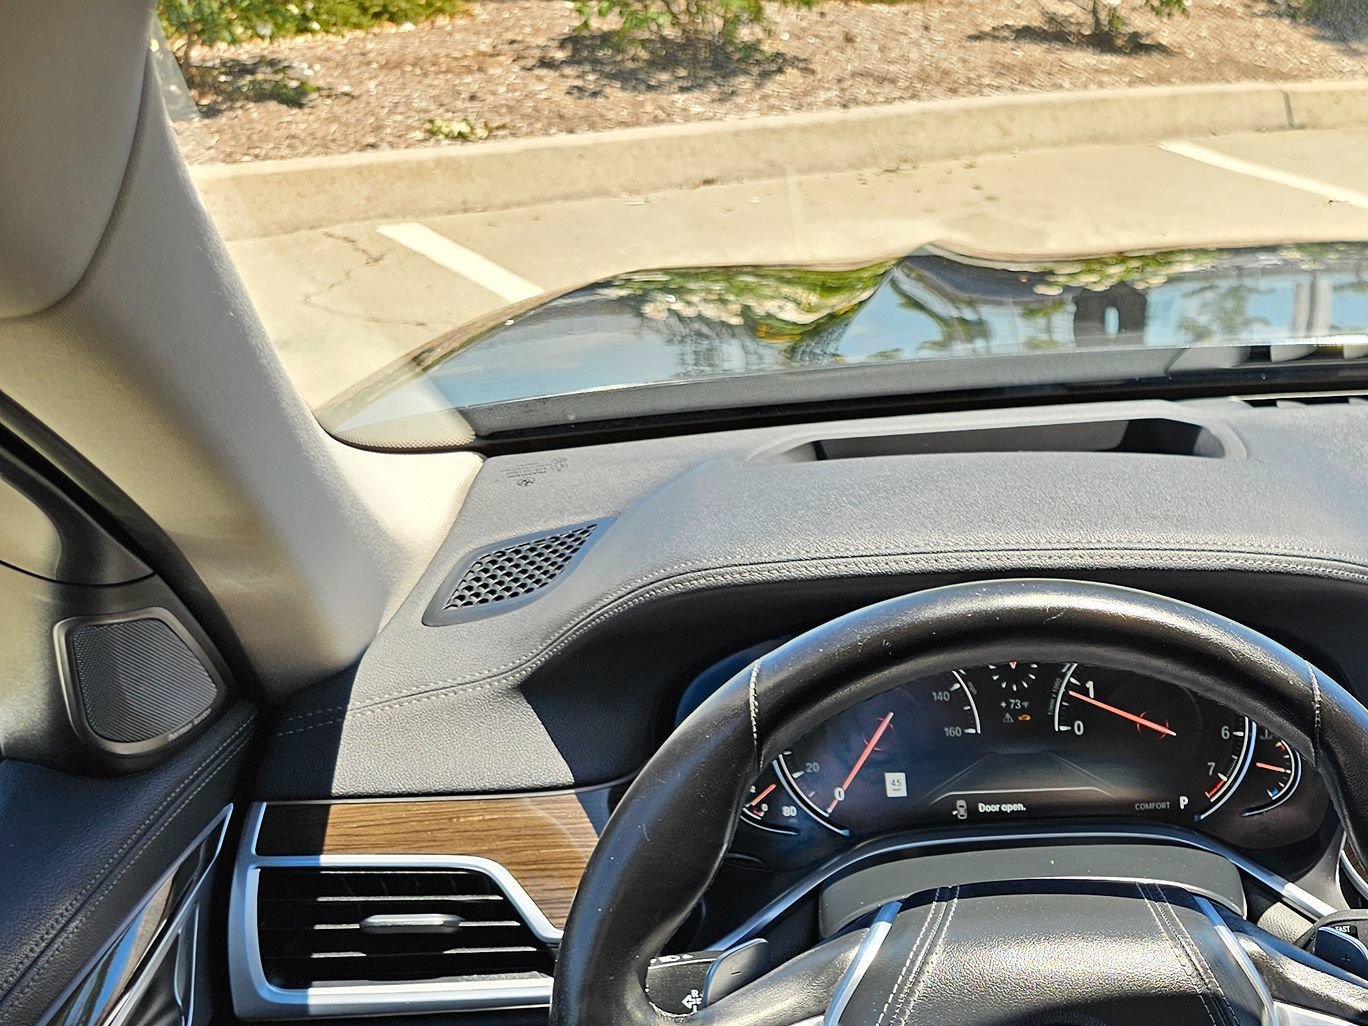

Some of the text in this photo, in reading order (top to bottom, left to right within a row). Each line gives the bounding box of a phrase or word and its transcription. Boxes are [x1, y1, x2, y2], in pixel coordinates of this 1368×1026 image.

[1086, 680, 1094, 698] 1
[932, 691, 950, 702] 140
[944, 727, 962, 736] 160
[1074, 721, 1084, 735] 0
[1221, 727, 1230, 739] 6
[806, 763, 820, 773] 20
[1207, 763, 1215, 775] 7
[891, 779, 902, 787] 45
[978, 803, 1027, 814] Door open.
[1135, 802, 1170, 810] COMFORT
[1179, 796, 1189, 810] P
[782, 806, 797, 817] 80
